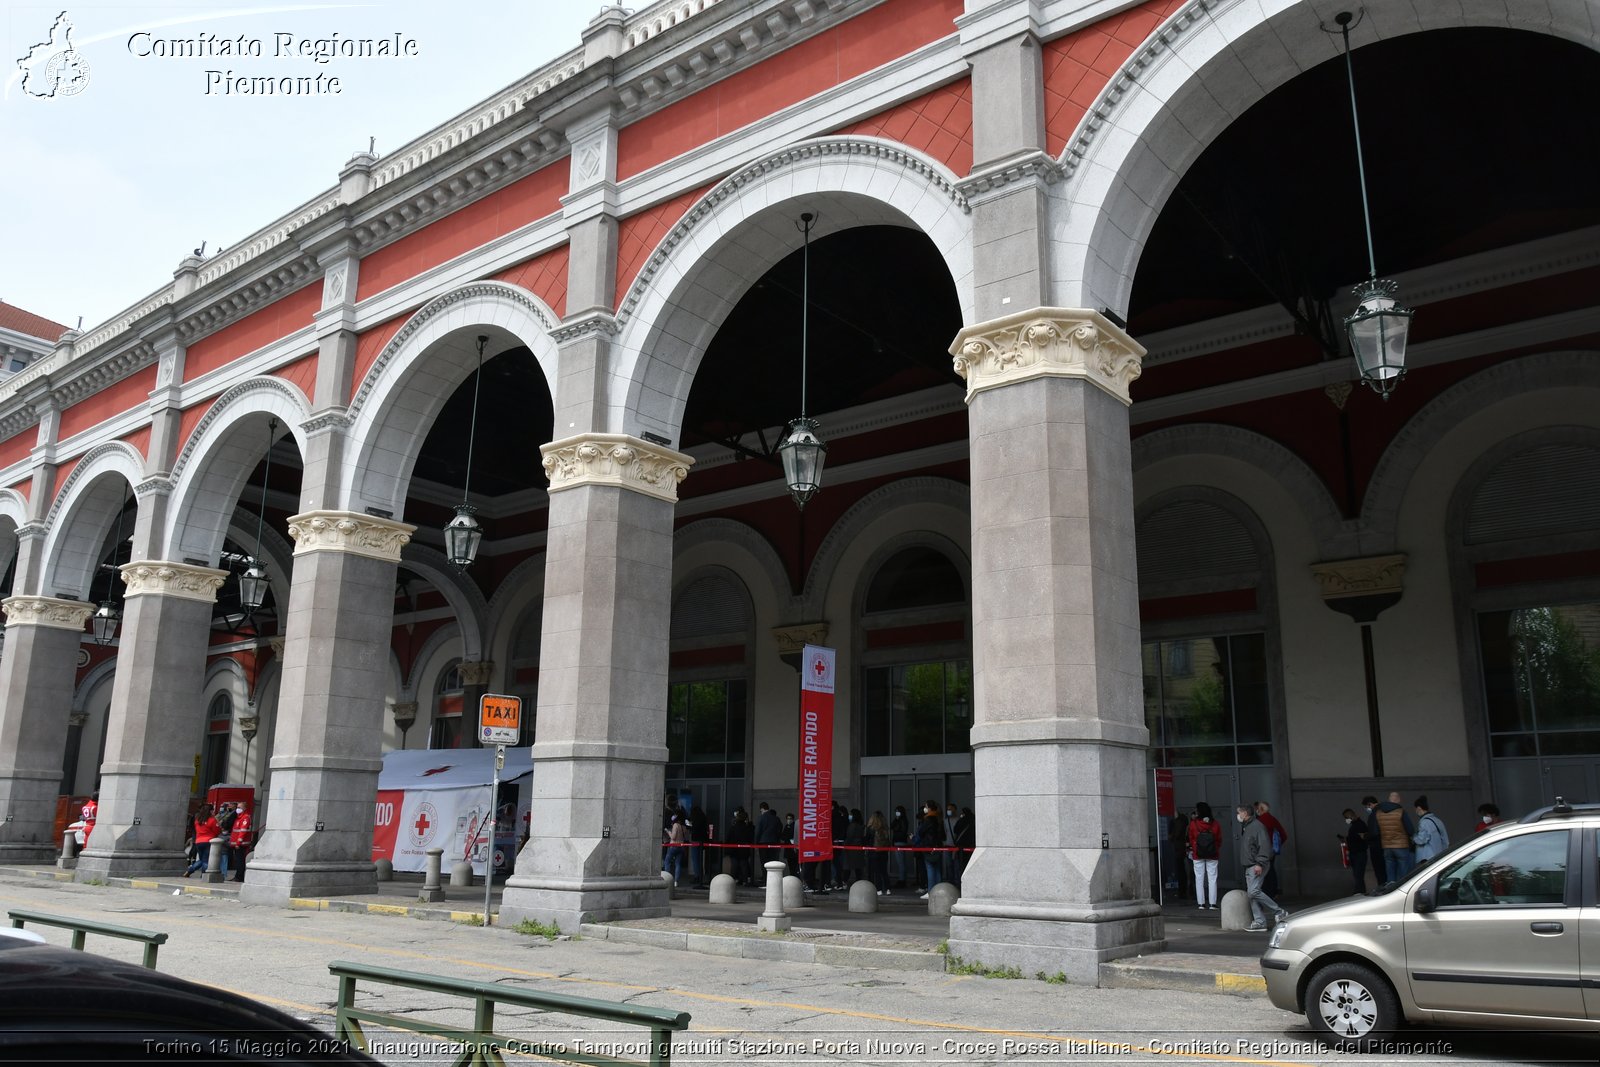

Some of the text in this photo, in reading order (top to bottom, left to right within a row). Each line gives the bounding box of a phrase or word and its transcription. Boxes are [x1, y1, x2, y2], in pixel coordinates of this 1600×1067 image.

[485, 705, 516, 720] TAXI
[805, 711, 818, 765] RAPIDO
[803, 769, 817, 840] TAMPONE
[818, 770, 831, 839] GRATUITO
